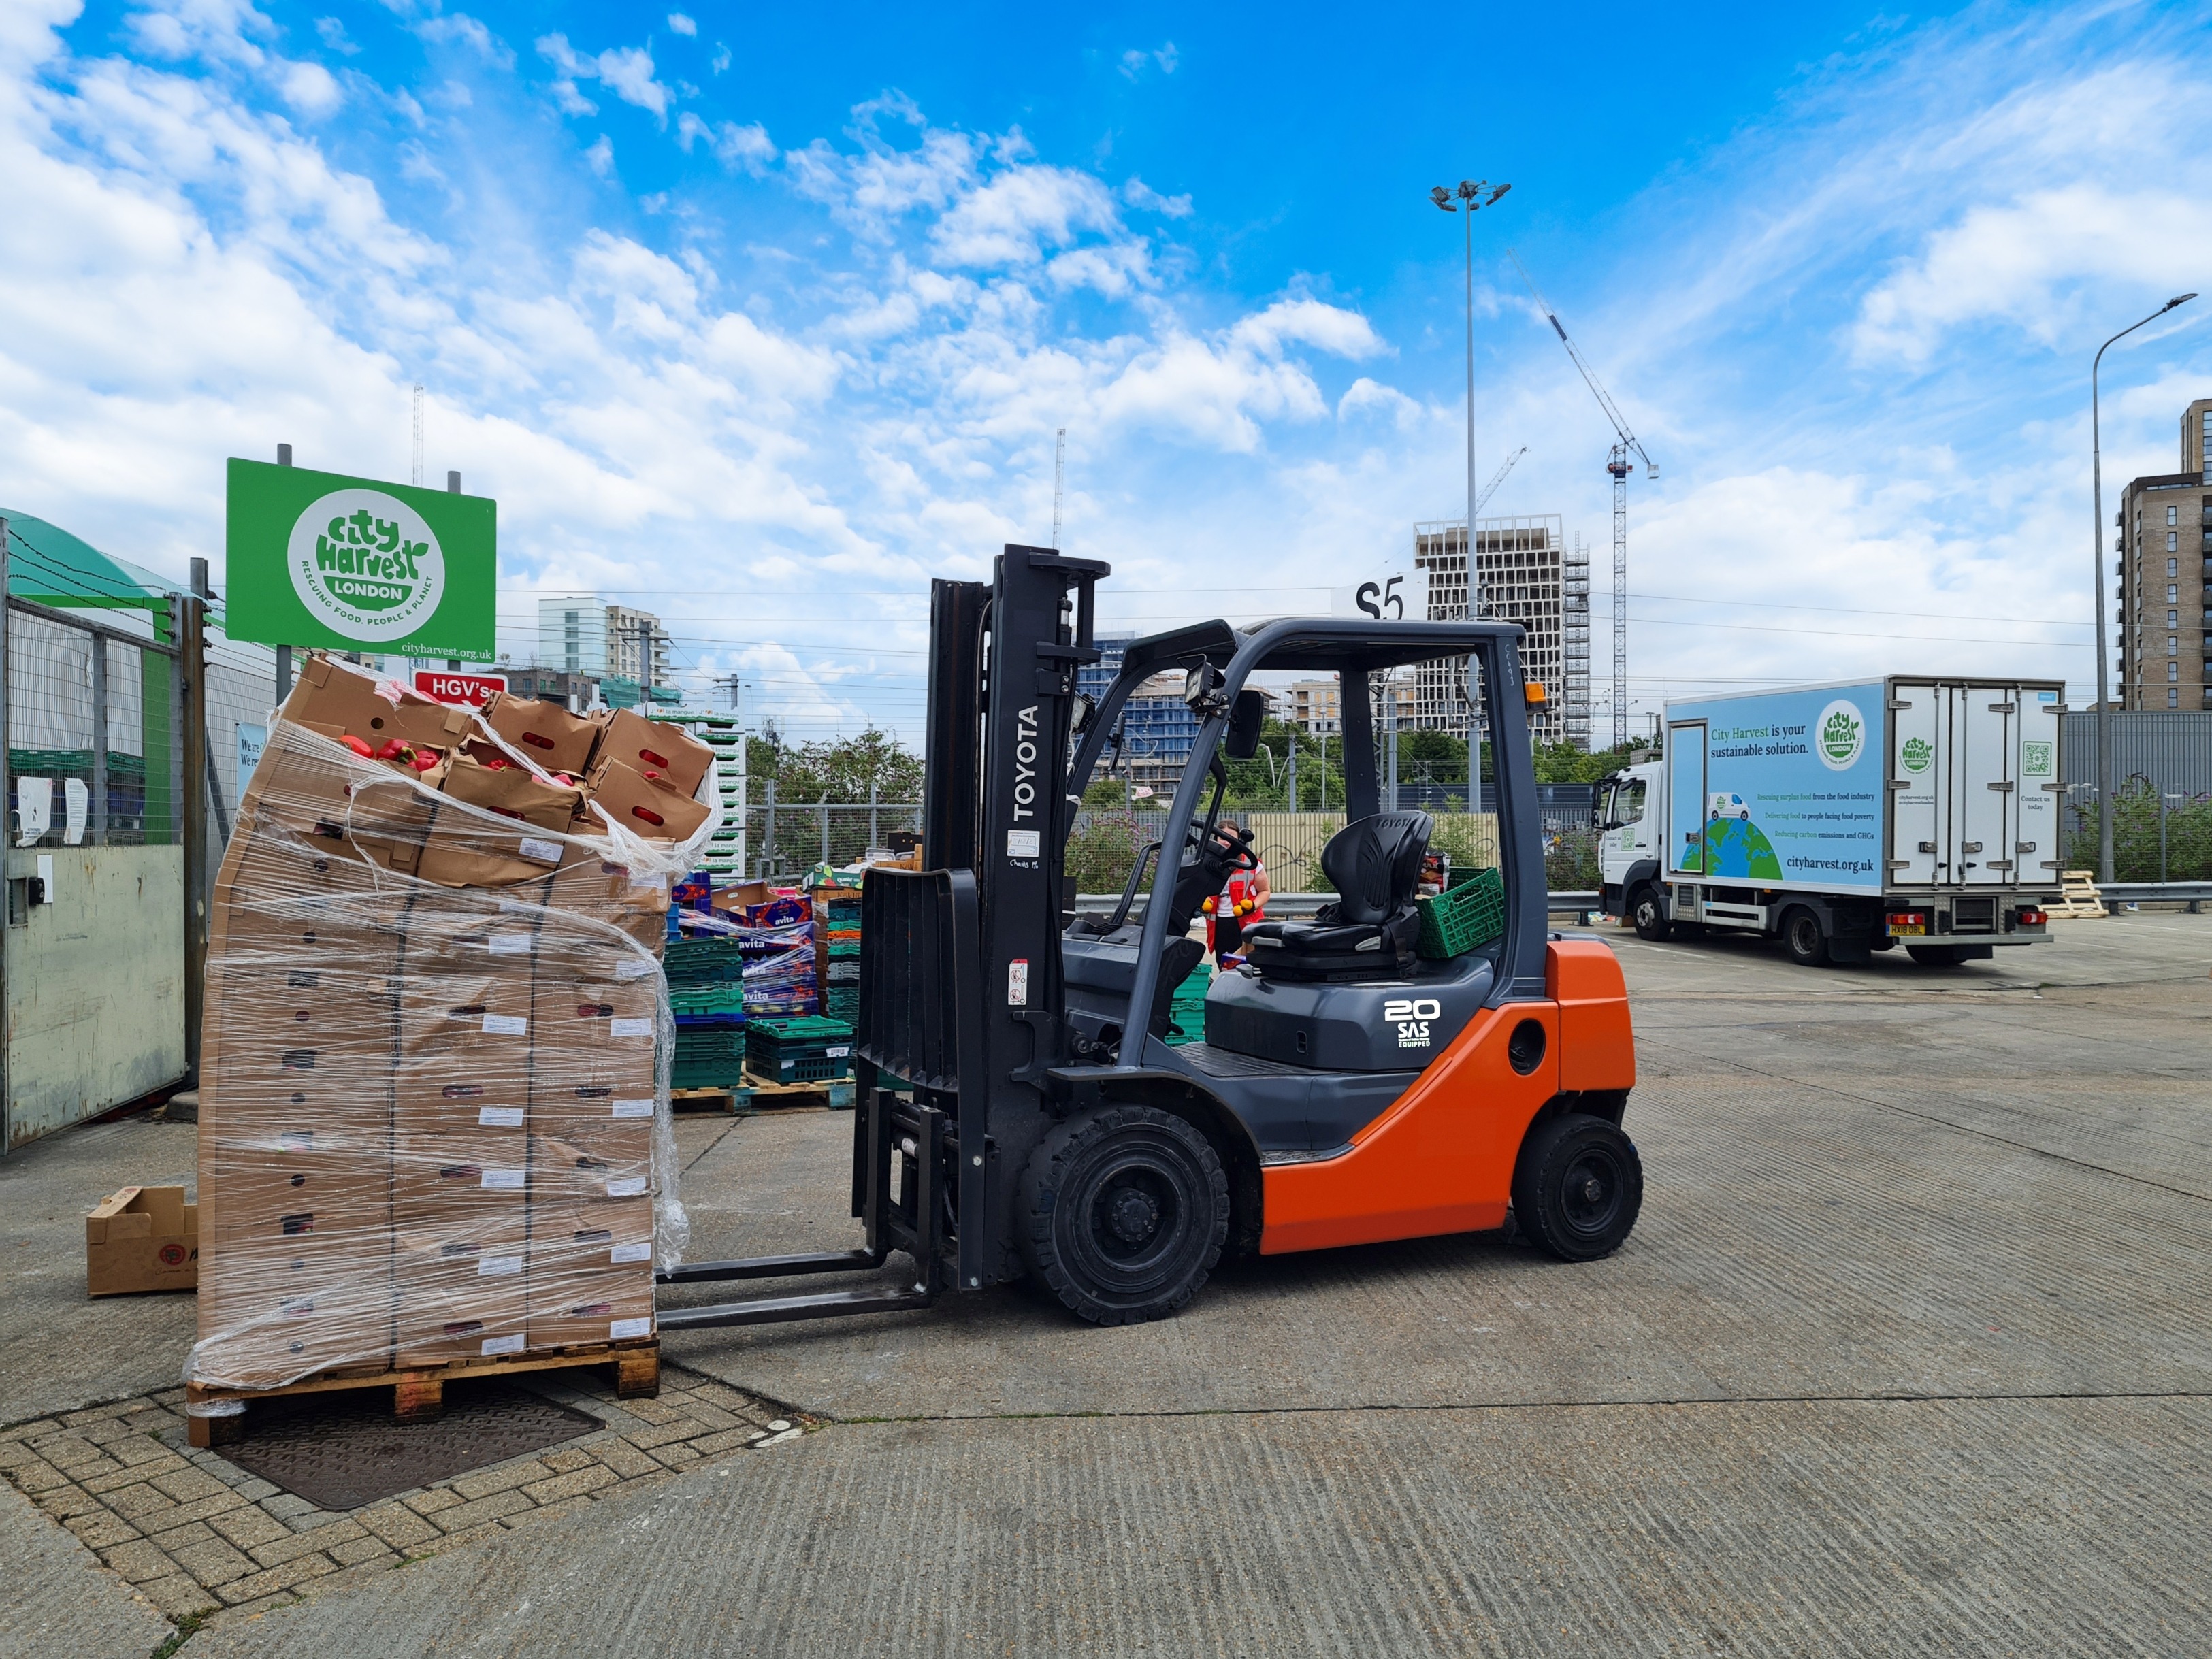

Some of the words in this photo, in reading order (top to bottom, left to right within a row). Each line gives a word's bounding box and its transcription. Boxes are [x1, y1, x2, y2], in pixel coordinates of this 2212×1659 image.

[316, 534, 429, 580] Harvest
[302, 561, 333, 607] RESCUING
[367, 612, 404, 625] PEOPLE
[411, 576, 433, 610] PLANET
[334, 580, 402, 600] LONDON
[402, 642, 492, 660] cityharvest.org.uk
[432, 678, 490, 698] HGV's
[1711, 729, 1730, 743] City
[1732, 726, 1769, 739] Harvest
[1772, 724, 1780, 736] is
[1782, 724, 1806, 739] your
[1824, 721, 1859, 743] Harvest
[1711, 744, 1763, 758] sustainable
[1765, 742, 1808, 755] solution.
[1902, 745, 1932, 759] Harvest
[241, 753, 250, 766] We
[1013, 704, 1038, 822] TOYOTA
[1757, 793, 1779, 802] Rescuing
[1780, 793, 1800, 802] surplus
[1851, 792, 1874, 801] industry
[1808, 812, 1823, 821] people
[1825, 812, 1840, 821] facing
[1775, 830, 1798, 838] Reducing
[1787, 856, 1874, 874] cityharvest.org.uk
[775, 915, 794, 925] avita
[738, 938, 765, 949] avita
[743, 989, 769, 1000] avita
[1384, 999, 1441, 1021] 20
[1397, 1021, 1430, 1038] SAS
